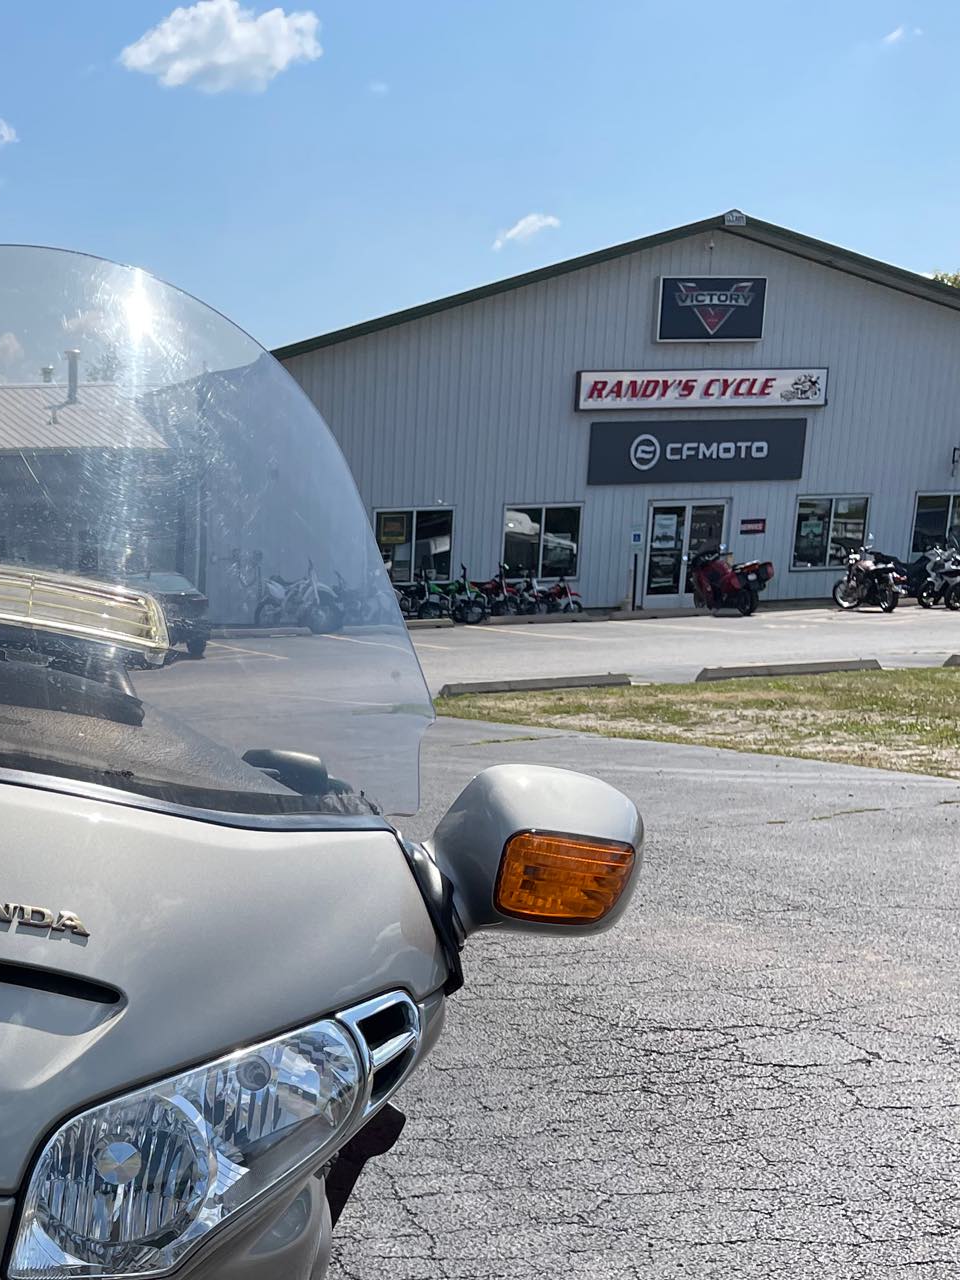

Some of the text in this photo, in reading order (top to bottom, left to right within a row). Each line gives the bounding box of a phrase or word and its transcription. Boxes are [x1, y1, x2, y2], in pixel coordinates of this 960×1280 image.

[677, 292, 751, 304] VICTORY
[587, 378, 776, 400] RANDY'S CYCLE
[665, 441, 769, 460] CFMOTO
